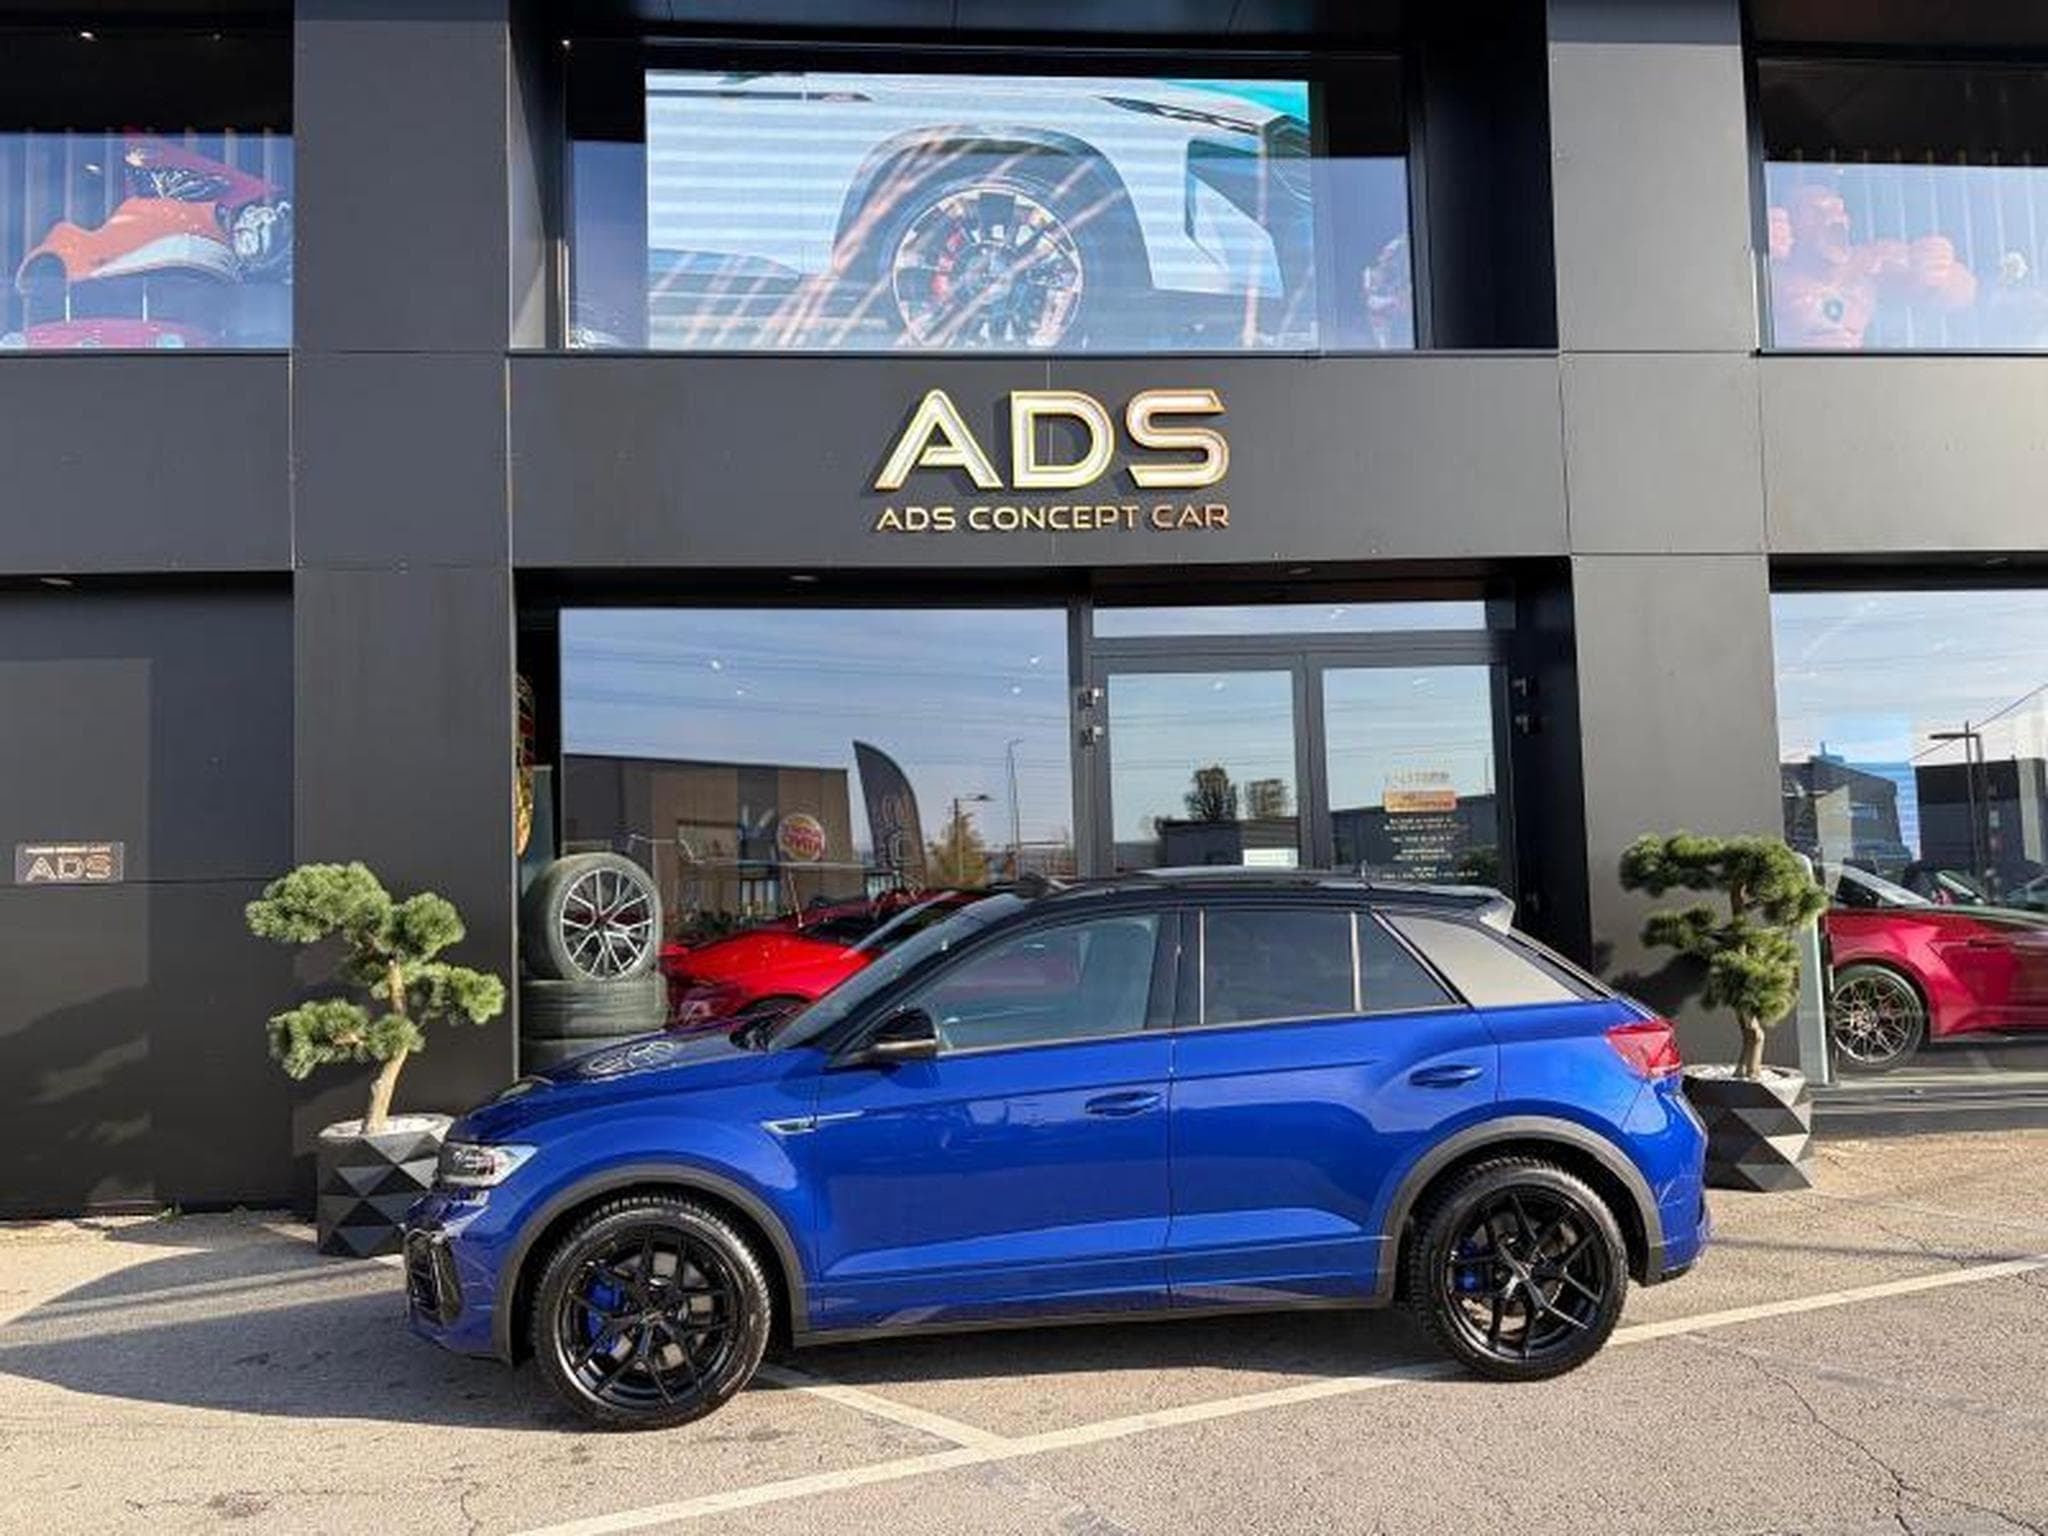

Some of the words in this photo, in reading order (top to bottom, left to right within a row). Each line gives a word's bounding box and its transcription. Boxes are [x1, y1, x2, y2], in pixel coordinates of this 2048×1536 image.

[874, 388, 1231, 489] ADS
[876, 506, 956, 531] ADS
[968, 505, 1140, 531] CONCEPT
[1151, 503, 1230, 529] CAR
[25, 854, 112, 881] ADS
